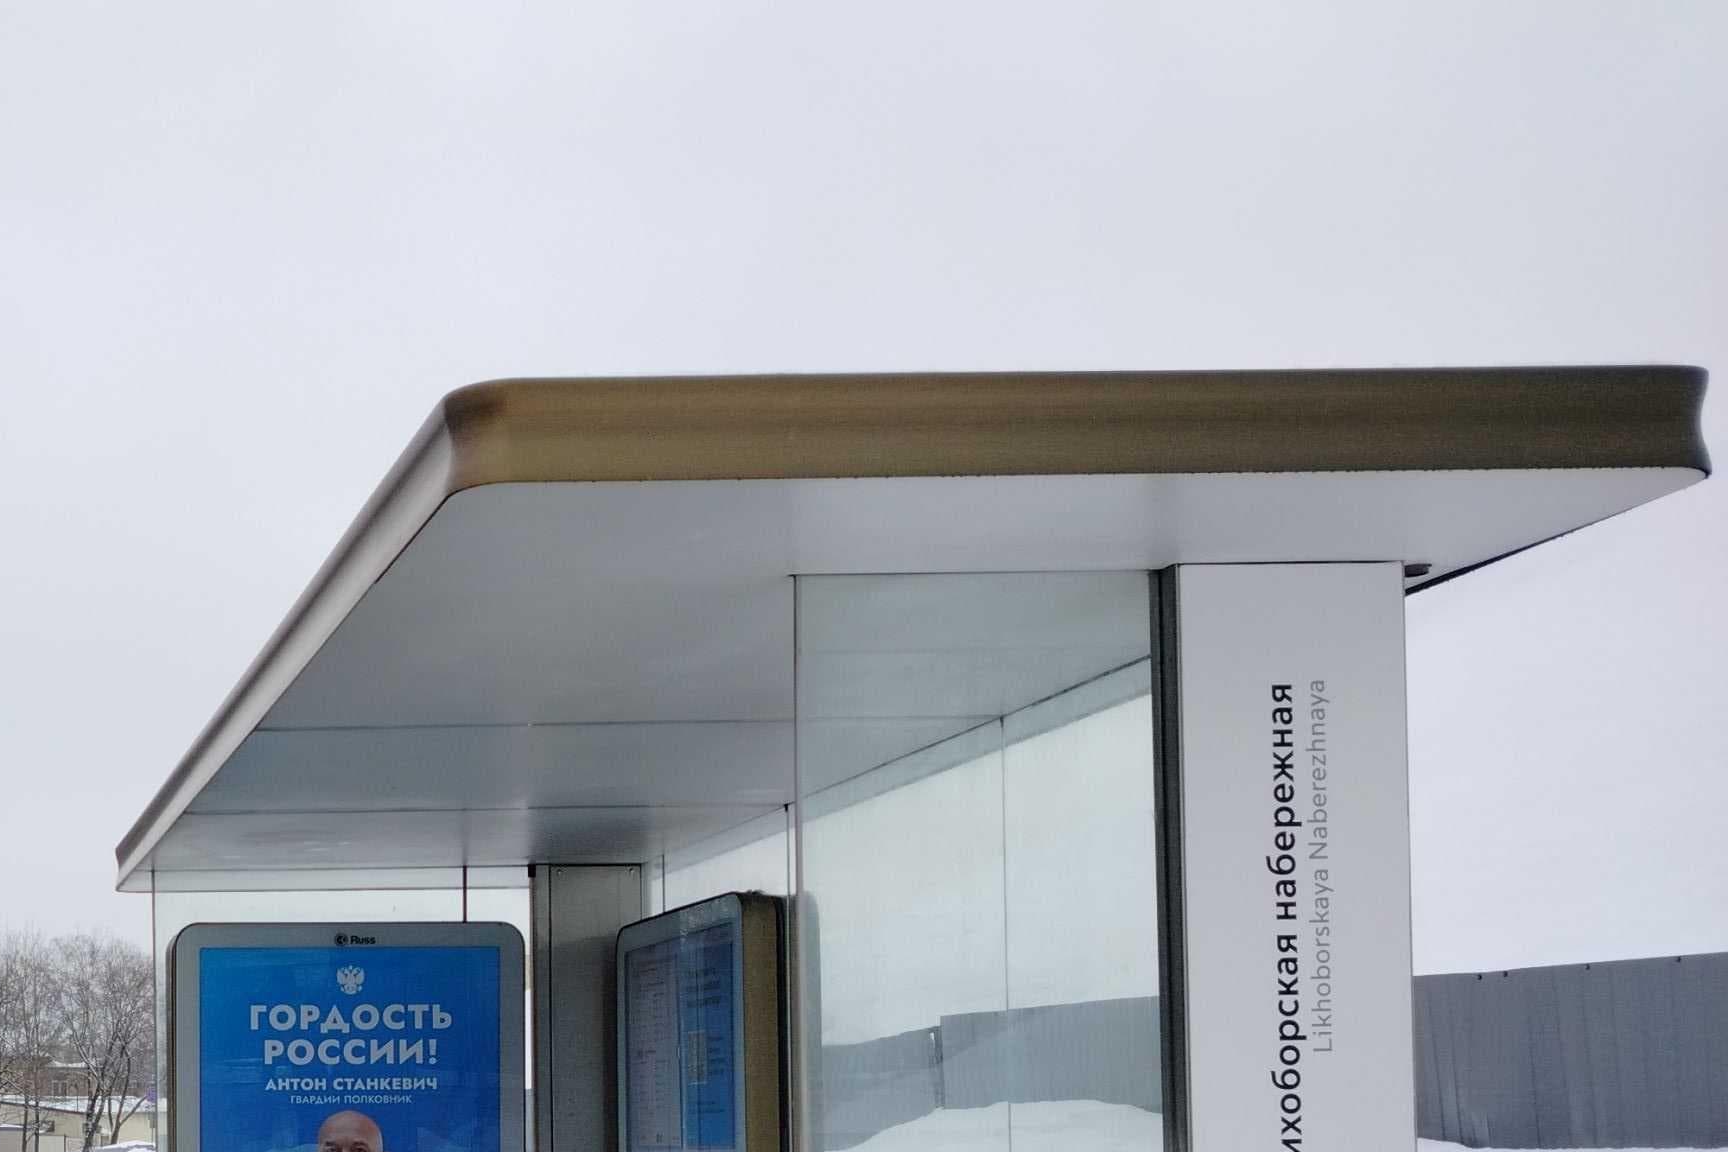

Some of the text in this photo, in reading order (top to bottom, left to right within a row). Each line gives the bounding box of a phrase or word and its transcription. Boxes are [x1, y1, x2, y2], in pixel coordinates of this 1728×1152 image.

[1265, 684, 1303, 921] набережная
[1305, 680, 1334, 1053] Likhoborskaya Naberezhnaya
[249, 1003, 453, 1034] ГОРДОСТЬ
[263, 1038, 440, 1066] РОССИИ!
[265, 1077, 438, 1092] АНТОН СТАНКЕВИЧ
[290, 1094, 413, 1106] ГВАРДИИ ПОЛКОВНИК
